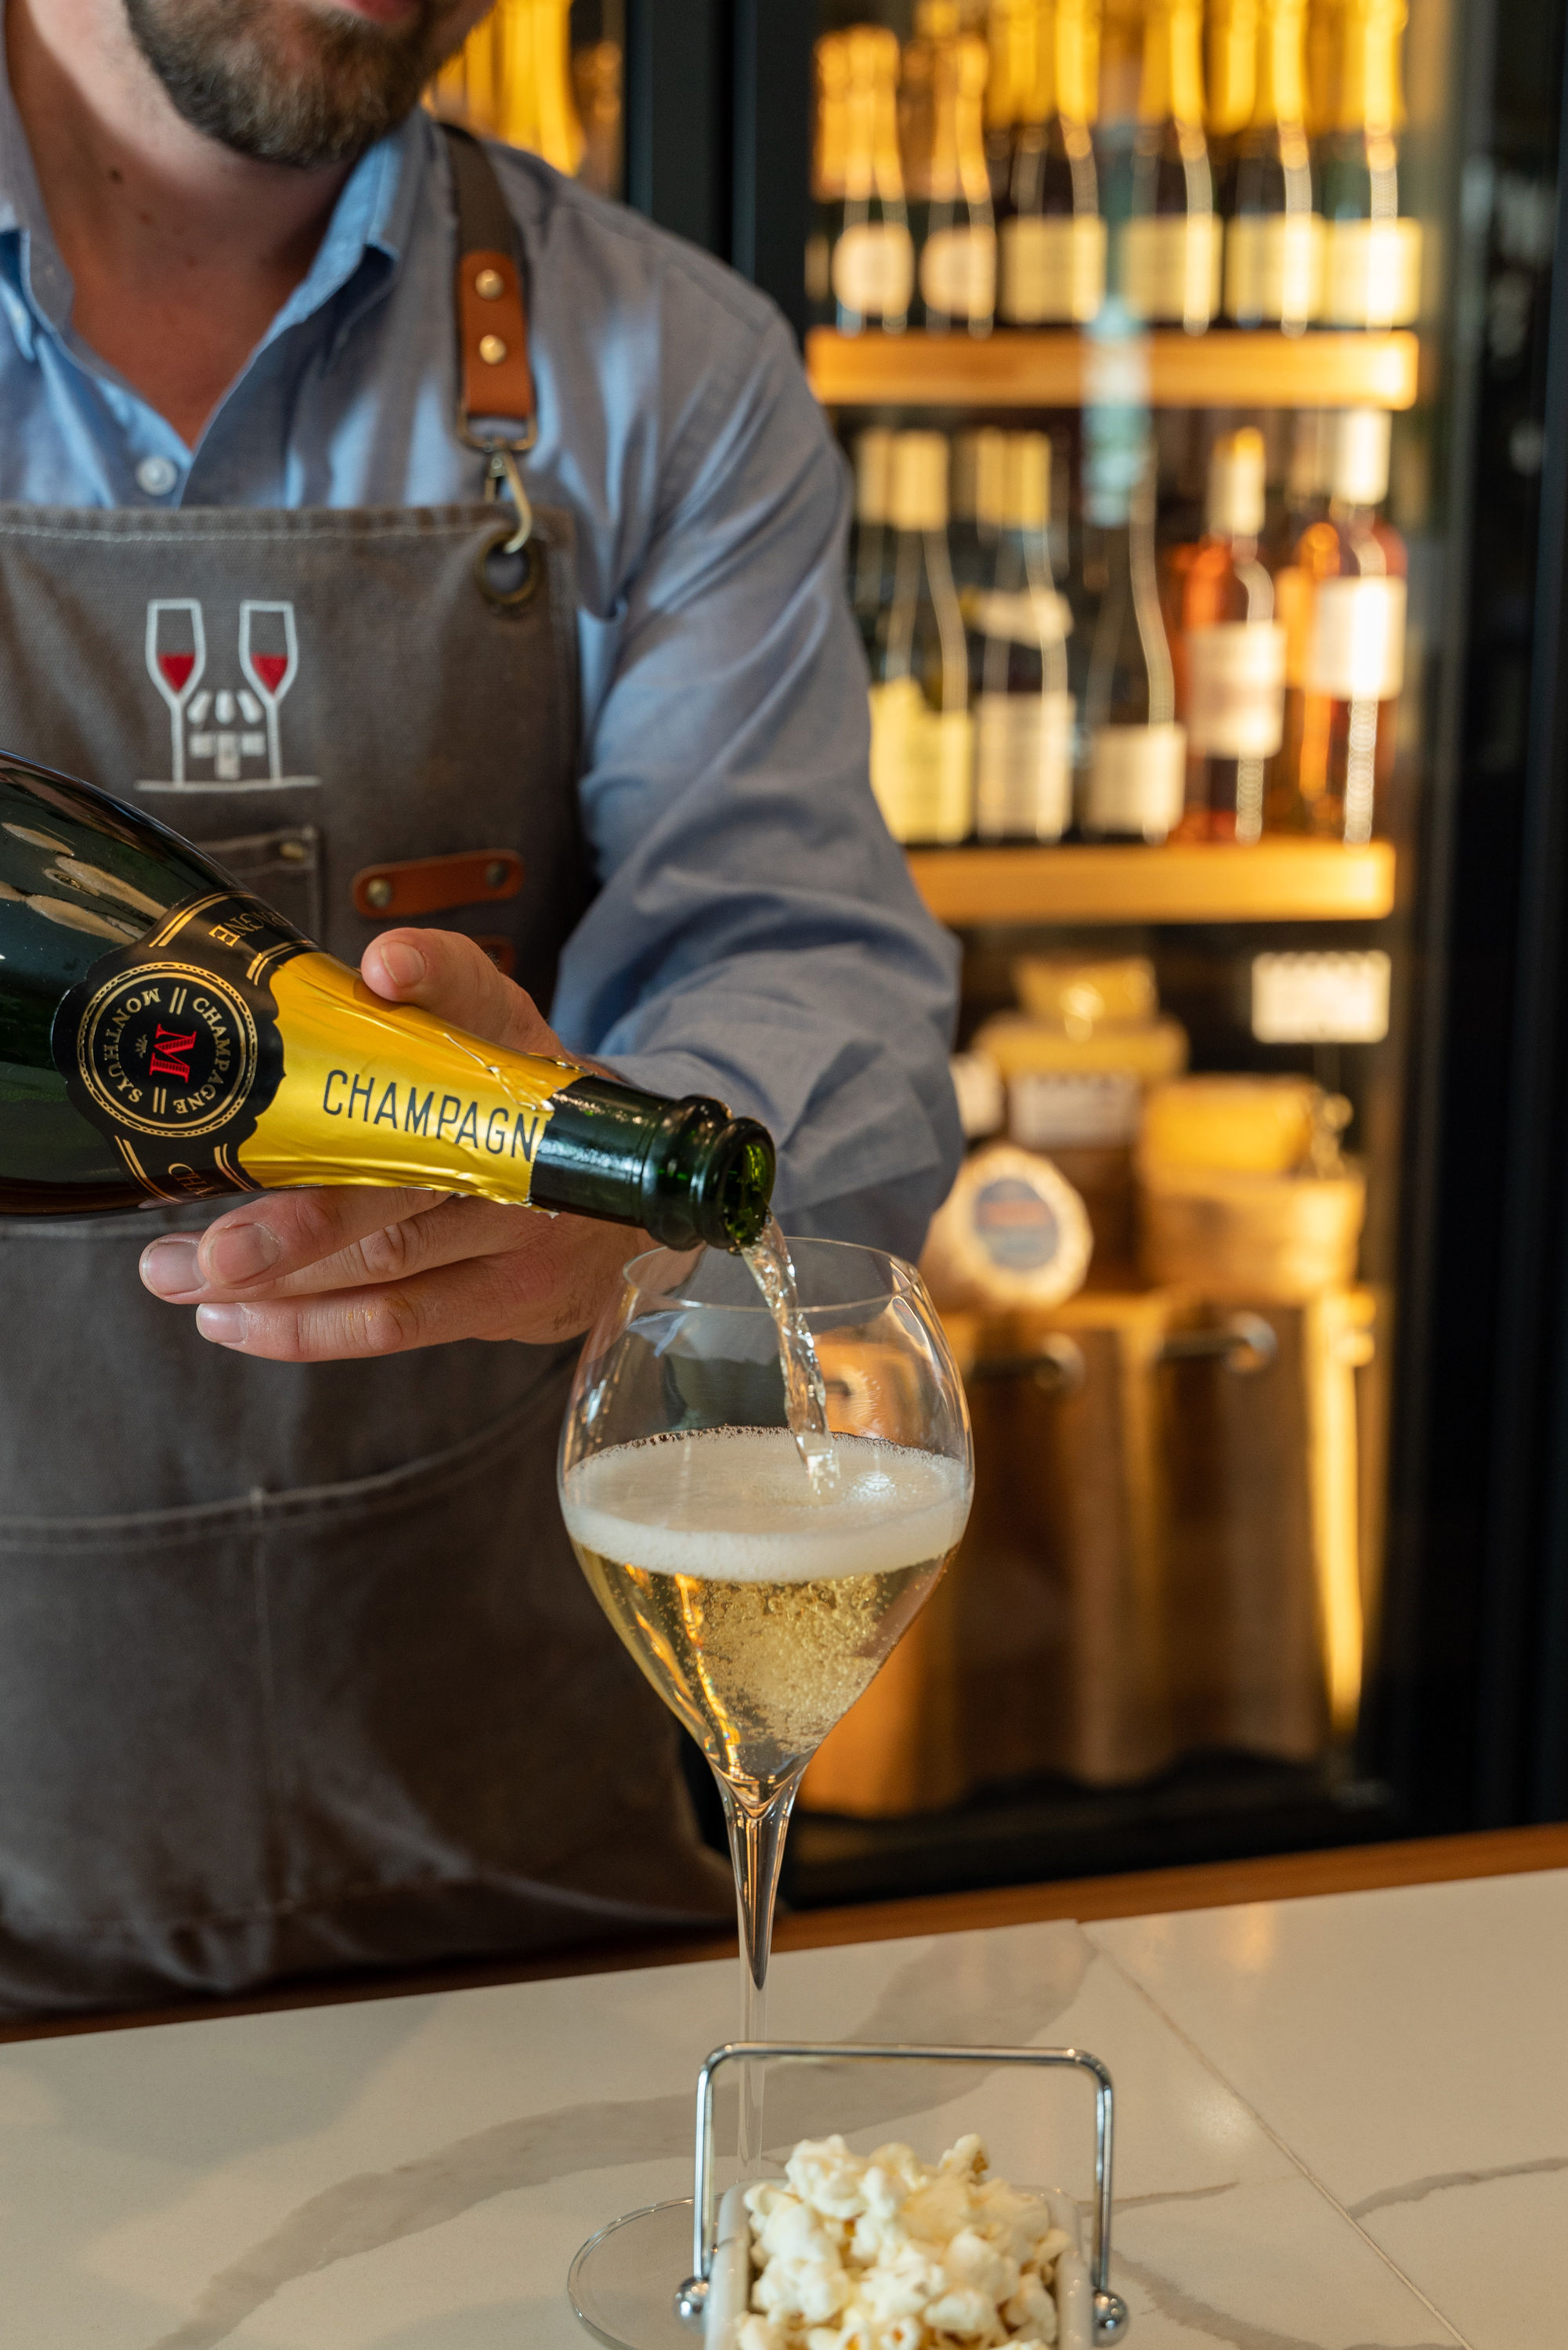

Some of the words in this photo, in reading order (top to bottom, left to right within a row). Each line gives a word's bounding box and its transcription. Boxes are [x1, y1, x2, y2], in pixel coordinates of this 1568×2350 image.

[103, 987, 161, 1103] MONTHUYS
[149, 1023, 197, 1084] M
[172, 996, 232, 1115] CHAMPAGNE
[323, 1068, 547, 1162] CHAMPAGN
